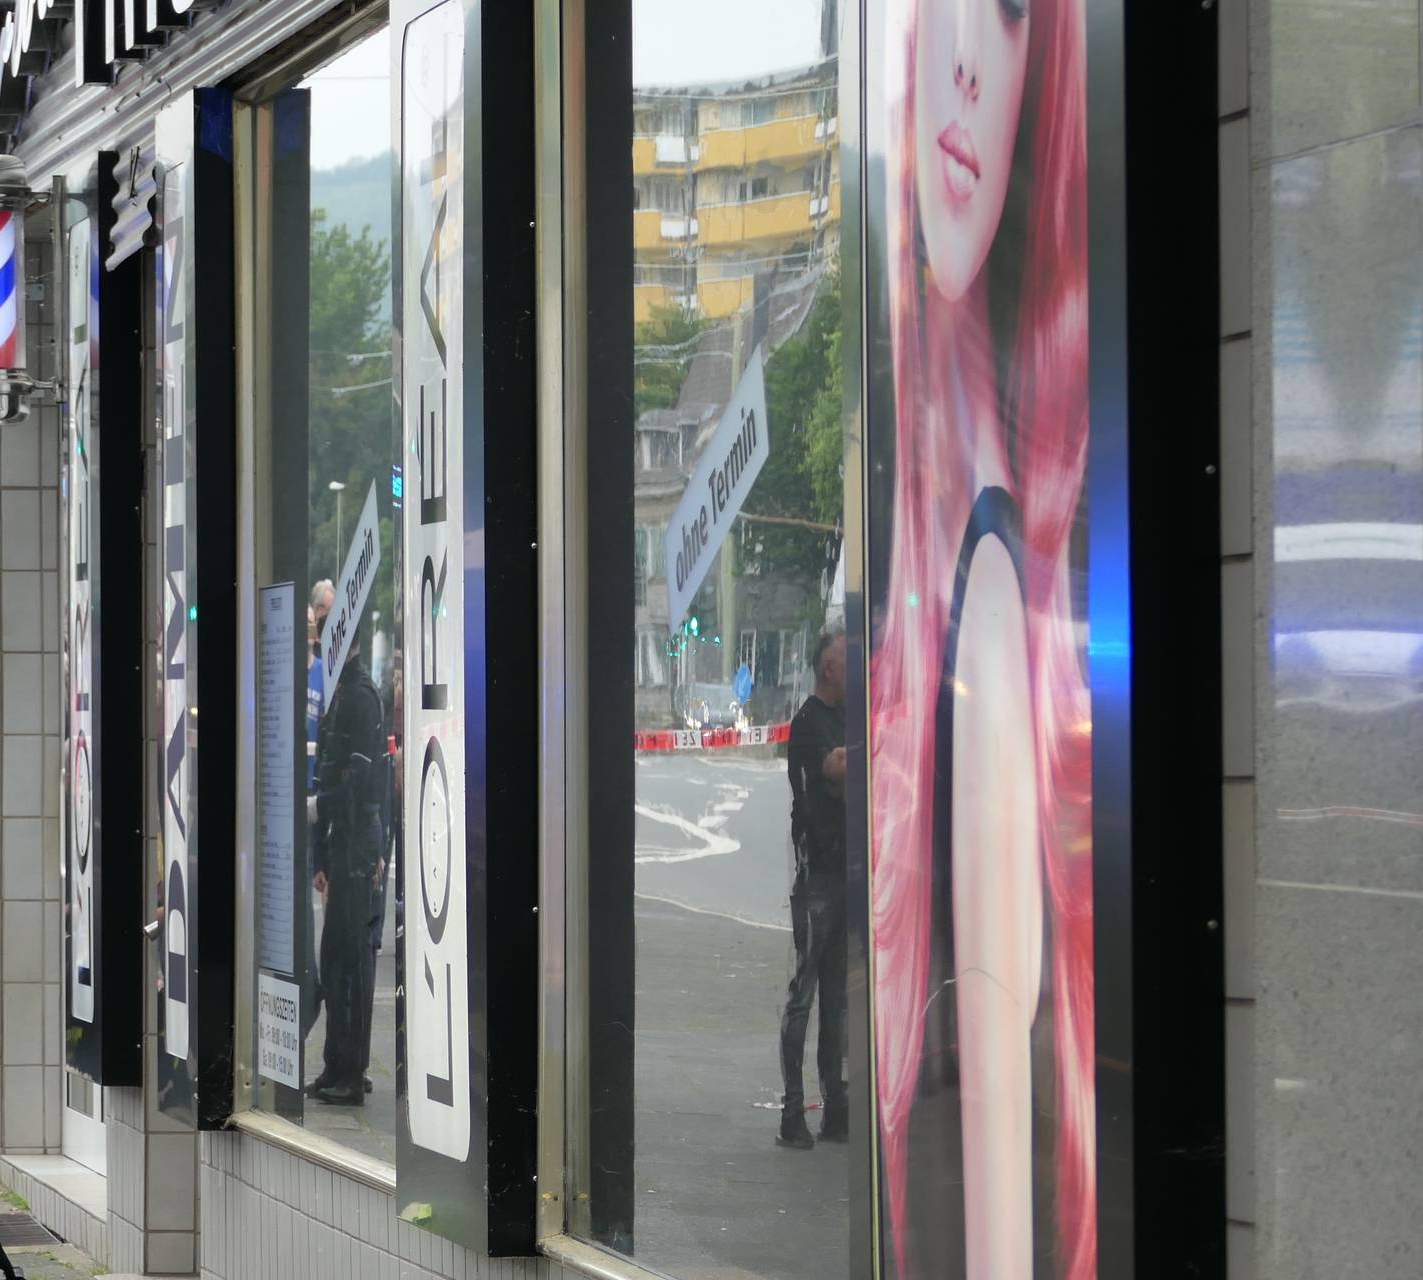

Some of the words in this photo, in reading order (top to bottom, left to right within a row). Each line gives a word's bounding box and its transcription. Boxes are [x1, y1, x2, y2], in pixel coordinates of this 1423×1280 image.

[676, 505, 708, 592] ohne
[708, 408, 757, 524] Termin
[163, 216, 187, 1004] DAMEN
[327, 611, 347, 678] ohne
[346, 527, 374, 621] Termin
